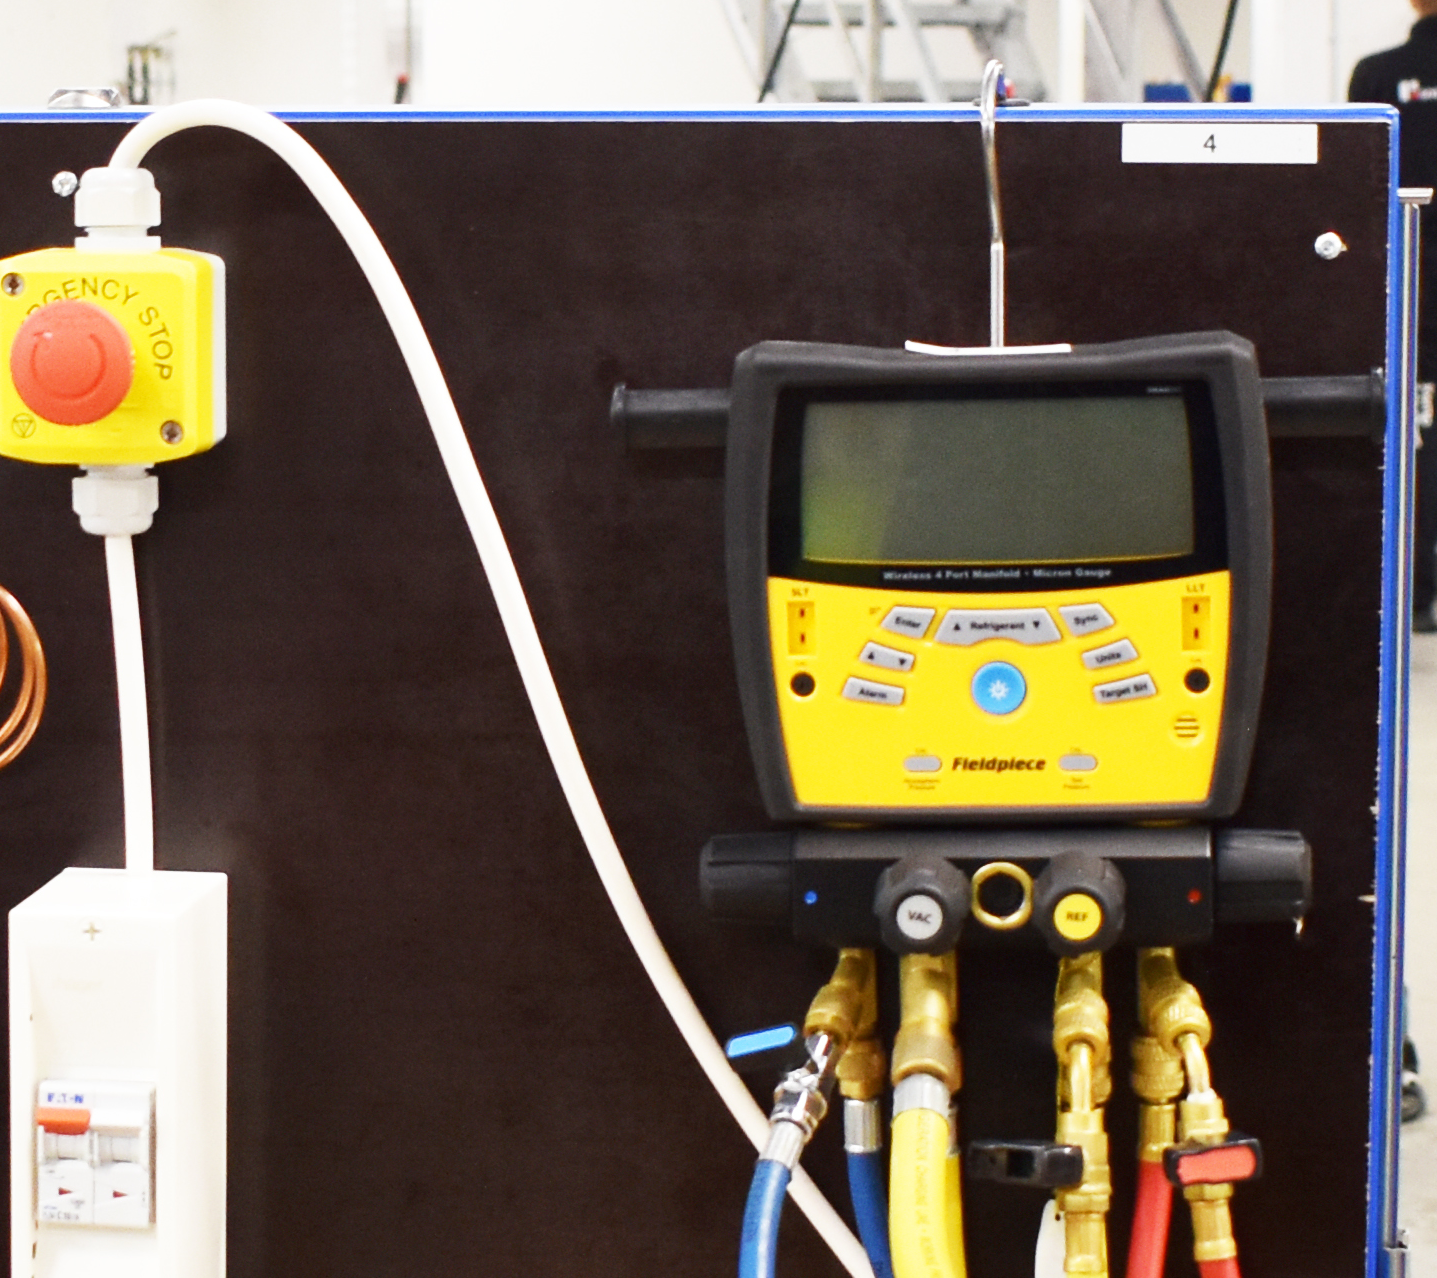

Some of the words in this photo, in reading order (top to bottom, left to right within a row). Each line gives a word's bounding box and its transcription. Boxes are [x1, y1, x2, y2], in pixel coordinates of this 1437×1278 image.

[1203, 133, 1218, 154] 4
[22, 277, 139, 321] RGENCY
[138, 306, 174, 381] STOP
[882, 569, 932, 581] Wireless
[945, 569, 970, 580] Port
[972, 567, 1021, 579] Manifold
[1032, 567, 1072, 578] Micron
[1074, 567, 1112, 579] Gauge
[894, 616, 922, 629] Enter
[969, 620, 1026, 634] Refrigerant
[1073, 612, 1100, 627] Sync
[858, 688, 888, 700] Alarm
[1099, 685, 1131, 701] Target
[951, 755, 1047, 776] Fieldpiece
[907, 909, 933, 924] VAC
[1065, 909, 1089, 924] REF
